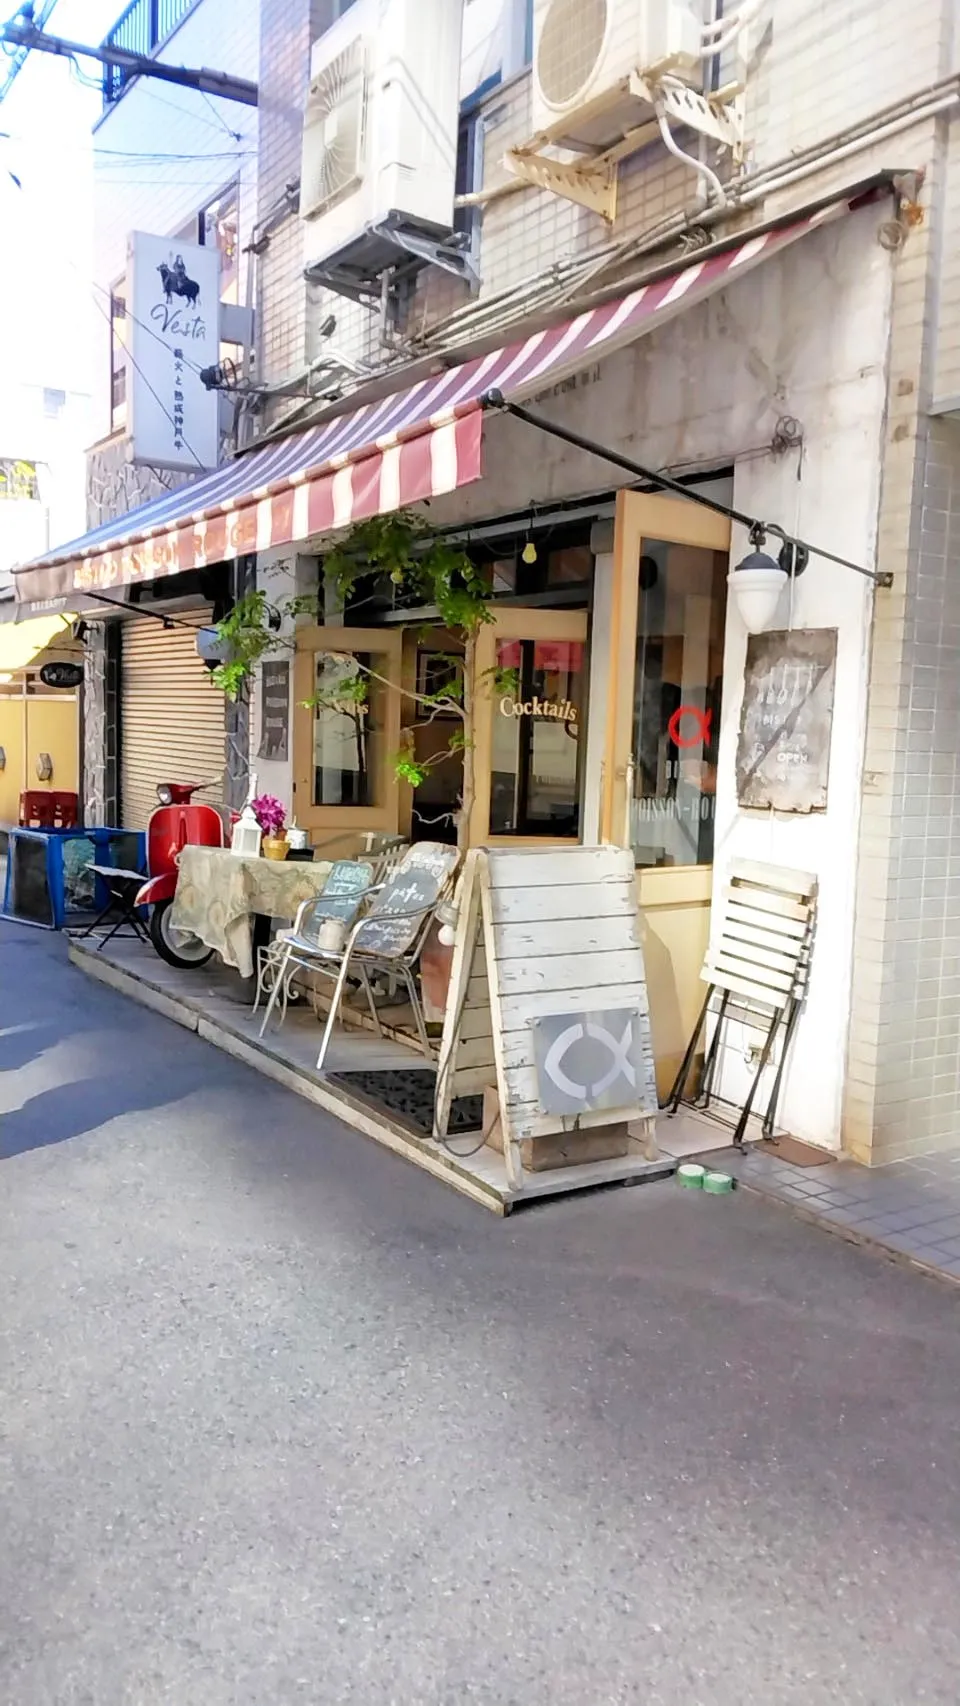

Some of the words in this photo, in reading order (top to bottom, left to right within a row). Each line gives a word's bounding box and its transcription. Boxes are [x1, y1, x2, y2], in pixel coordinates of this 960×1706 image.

[150, 303, 206, 341] Vesta
[500, 696, 577, 722] Cocktails
[776, 752, 808, 764] OPEN
